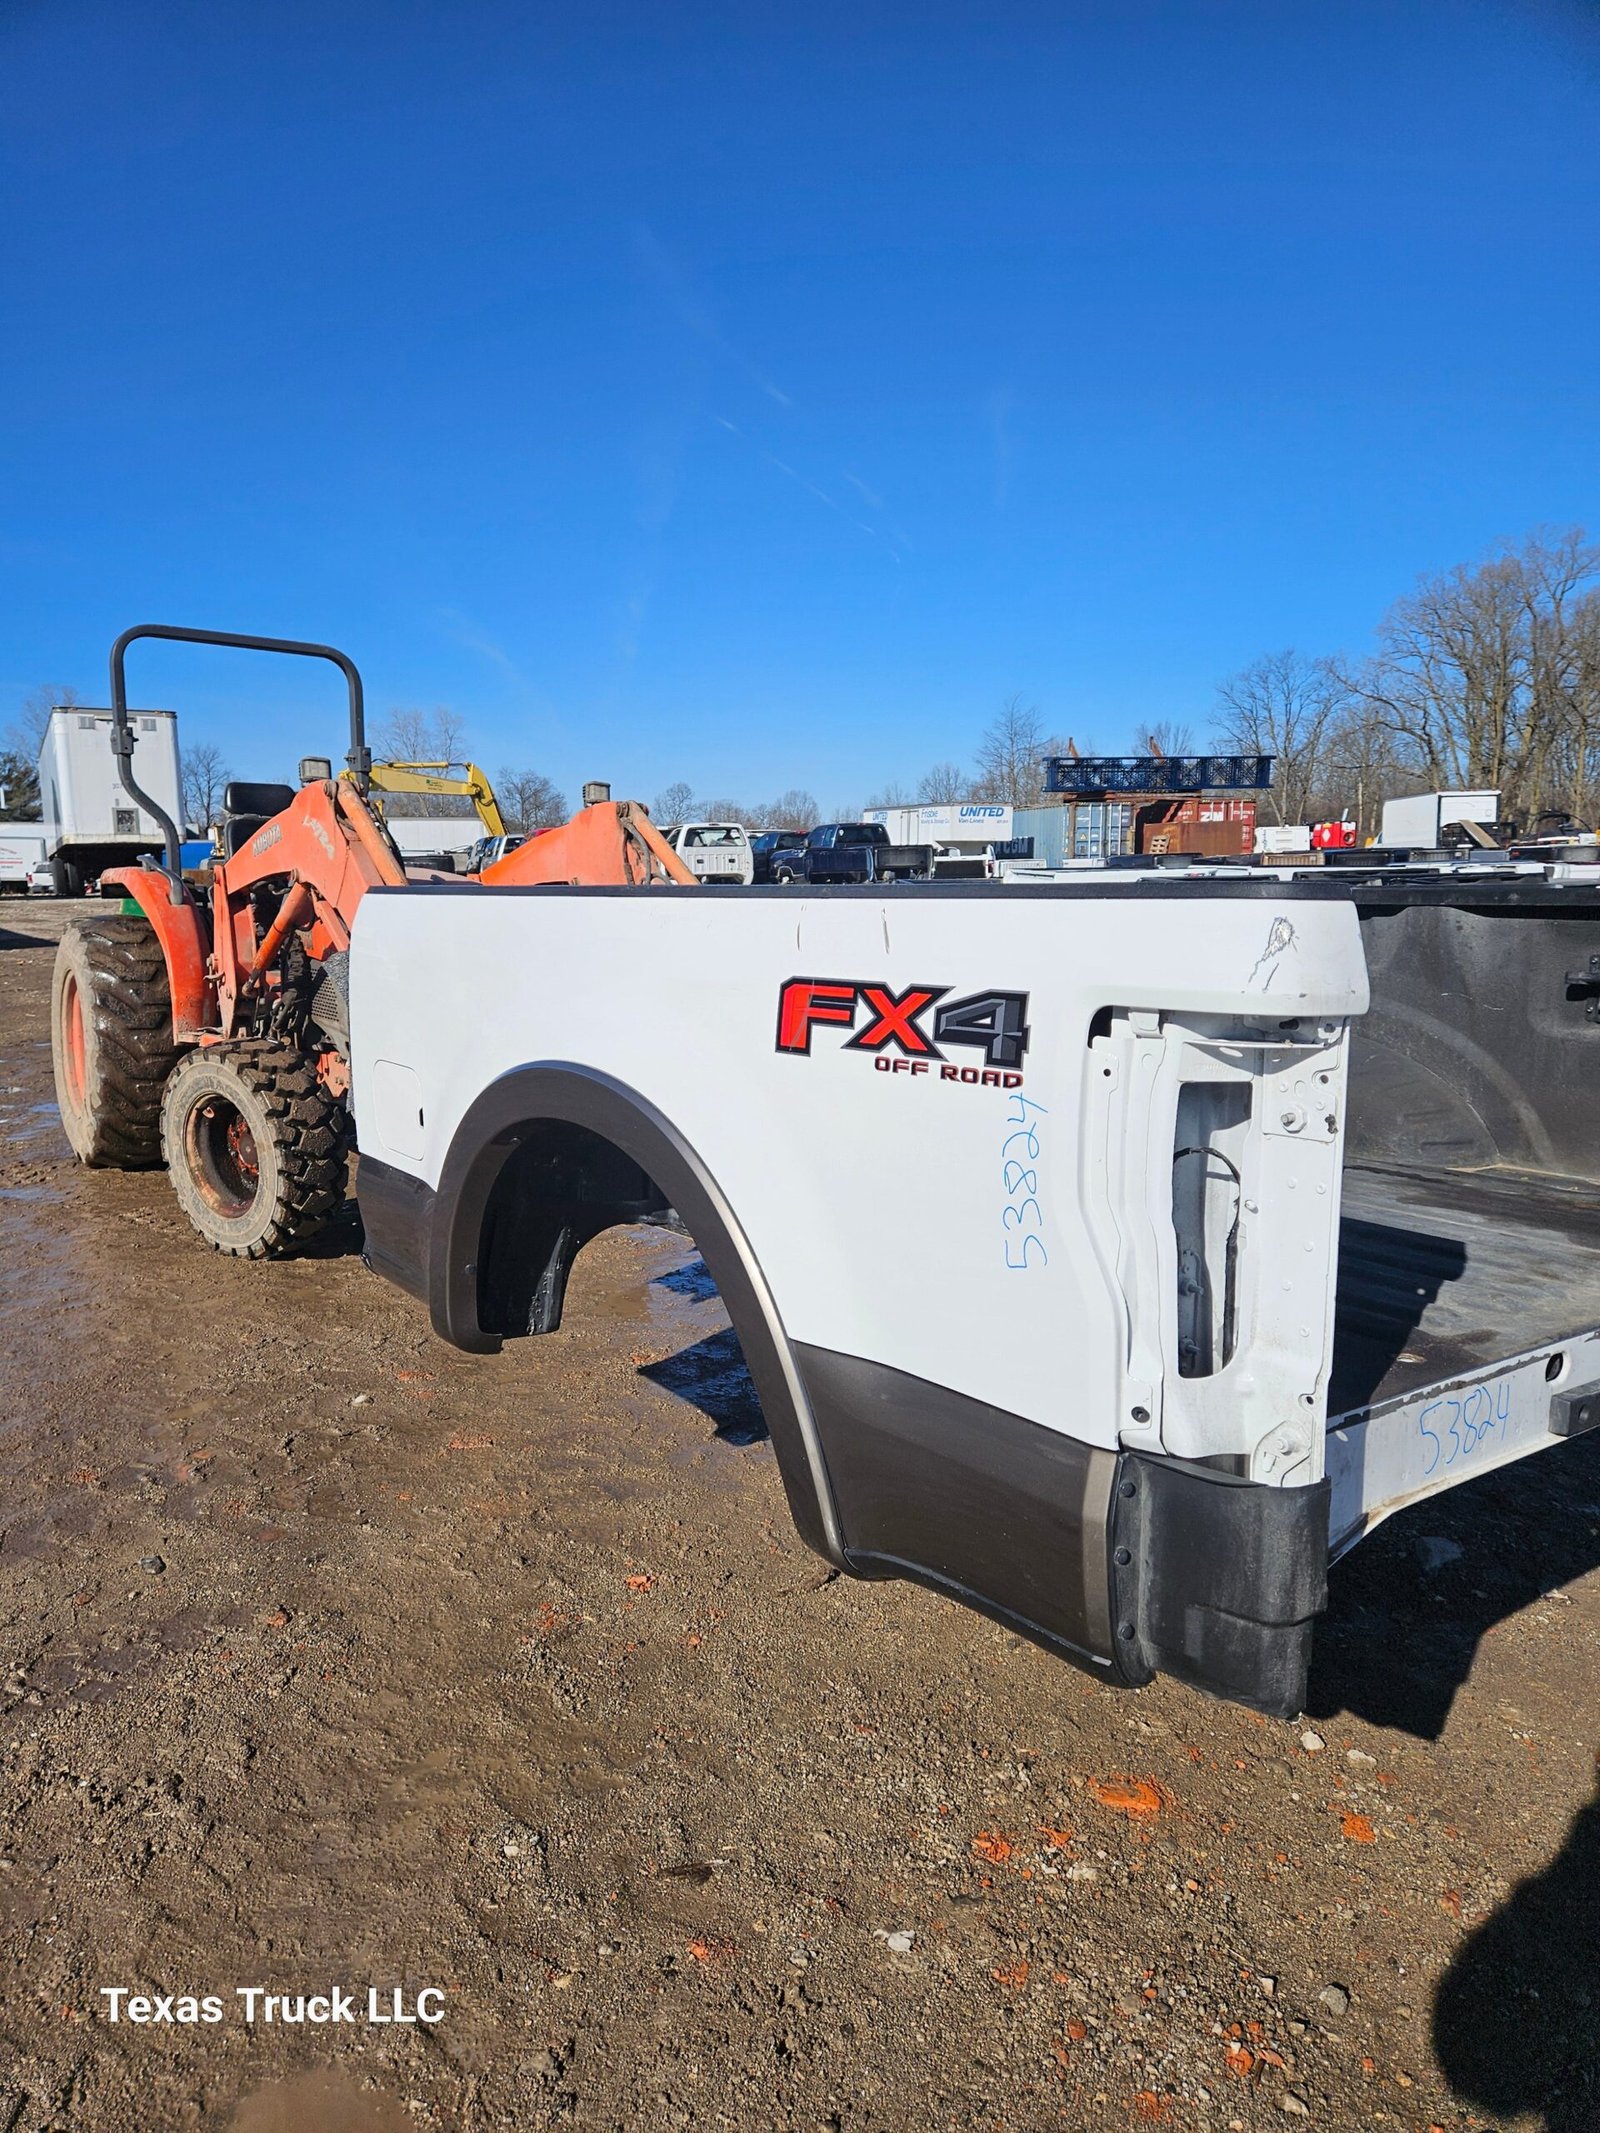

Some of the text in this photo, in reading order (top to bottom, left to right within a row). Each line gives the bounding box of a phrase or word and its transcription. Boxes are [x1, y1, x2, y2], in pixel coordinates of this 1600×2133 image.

[960, 806, 1004, 817] UNITED
[775, 976, 1031, 1071] FX4
[874, 1055, 1024, 1089] OFF ROAD
[1002, 1092, 1048, 1269] 53824
[1419, 1383, 1509, 1475] 53824
